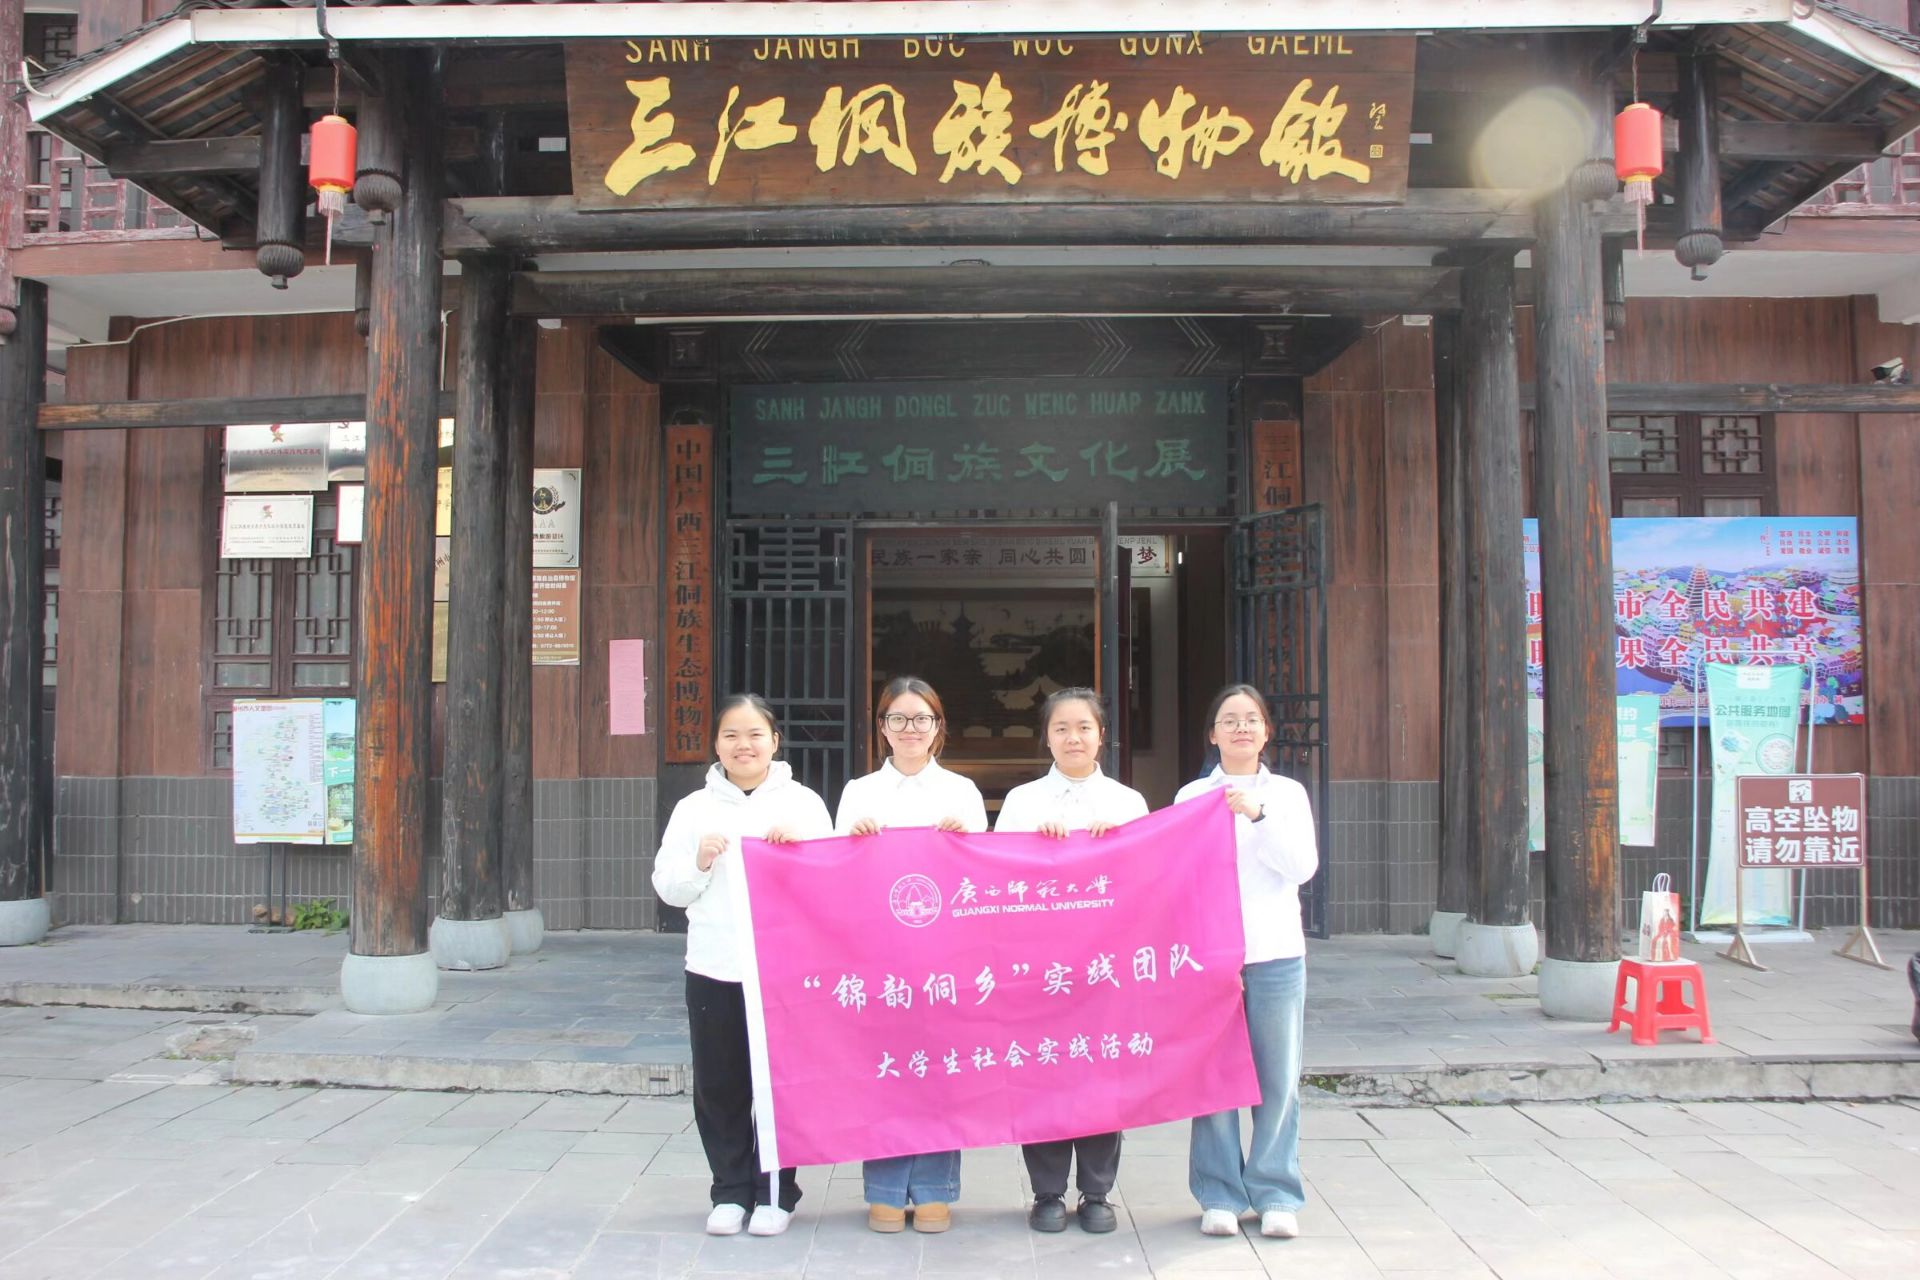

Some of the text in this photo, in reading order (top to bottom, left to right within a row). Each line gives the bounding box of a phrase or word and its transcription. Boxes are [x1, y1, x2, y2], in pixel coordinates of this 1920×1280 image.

[755, 397, 805, 420] SANH
[820, 396, 882, 419] JANGH
[895, 394, 958, 418] DONGL
[974, 394, 1012, 417] ZUC
[675, 439, 703, 751] 中国广西三江侗族生态博物馆
[1744, 806, 1859, 833] 高空坠物
[1745, 836, 1859, 863] 请勿靠近
[952, 899, 1115, 918] GUANGXI NORMAL UNIVERSITY
[803, 943, 1204, 1014] “锦韵侗乡”实践团队
[876, 1032, 1154, 1079] 大学生社会实践活动
